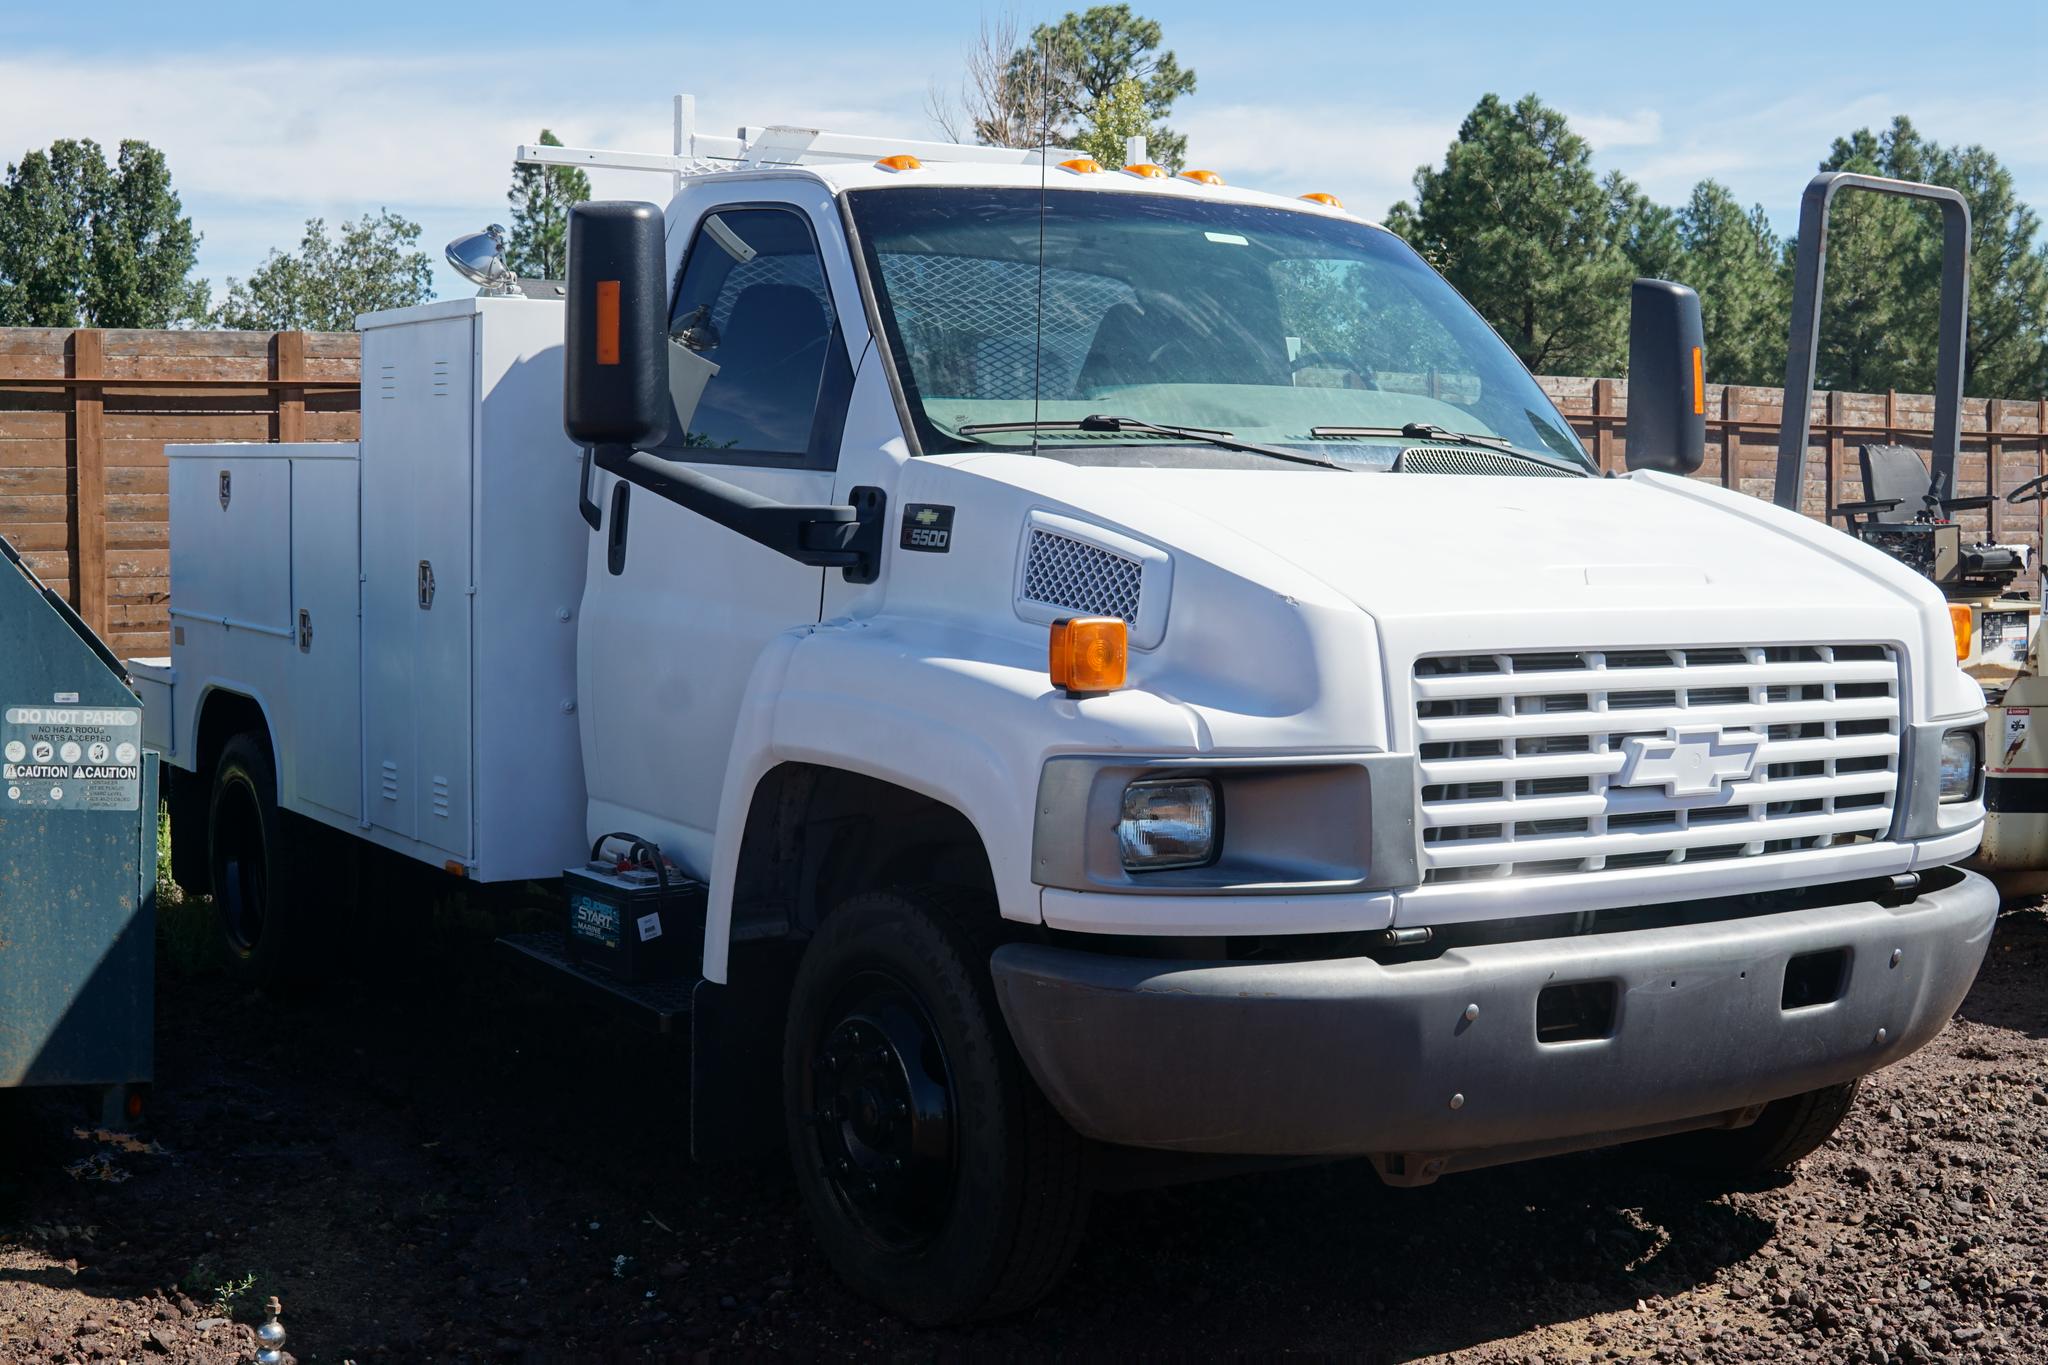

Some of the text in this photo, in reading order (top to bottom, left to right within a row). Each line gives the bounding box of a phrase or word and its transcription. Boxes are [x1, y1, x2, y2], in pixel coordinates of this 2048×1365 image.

[18, 709, 126, 725] DO NOT PARK
[31, 734, 112, 742] WASTES ACCEPTED
[17, 766, 68, 778] CAUTION
[85, 766, 136, 779] CAUTION
[577, 906, 613, 930] START
